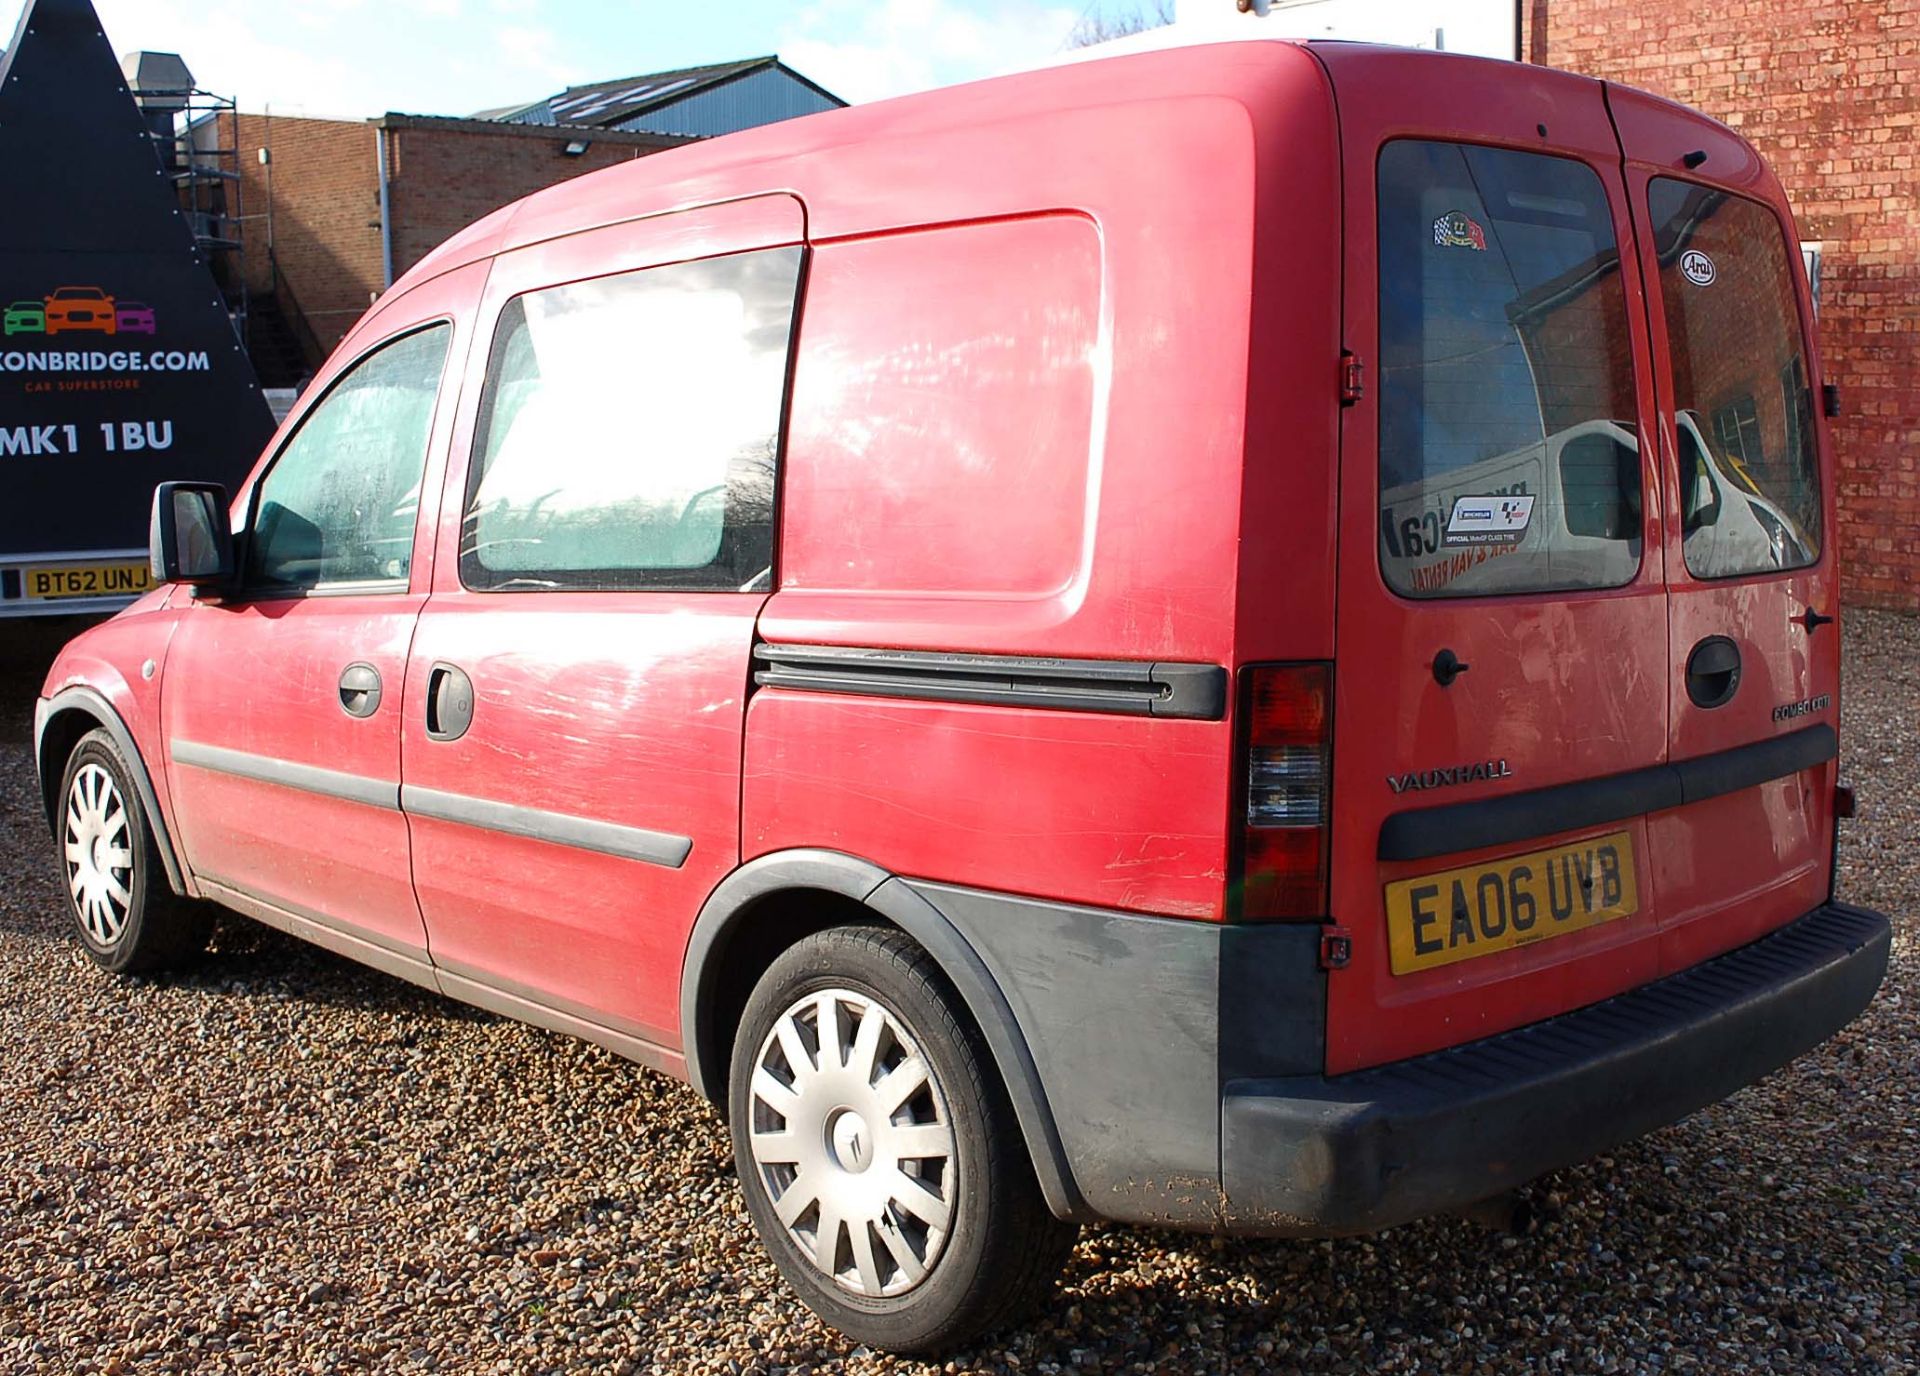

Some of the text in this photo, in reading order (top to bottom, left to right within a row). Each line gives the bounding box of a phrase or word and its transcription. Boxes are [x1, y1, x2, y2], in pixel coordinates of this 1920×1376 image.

[1685, 255, 1711, 276] Arai
[0, 351, 210, 371] ONBRIDGE.COM
[25, 379, 141, 392] CAR SUPERSTORE
[0, 420, 173, 456] MK1 1BU
[36, 568, 148, 593] BT62 UNJ
[1772, 700, 1810, 721] COMBO
[1387, 759, 1512, 793] VAUXHALL
[1409, 845, 1622, 956] EA06 UVB
